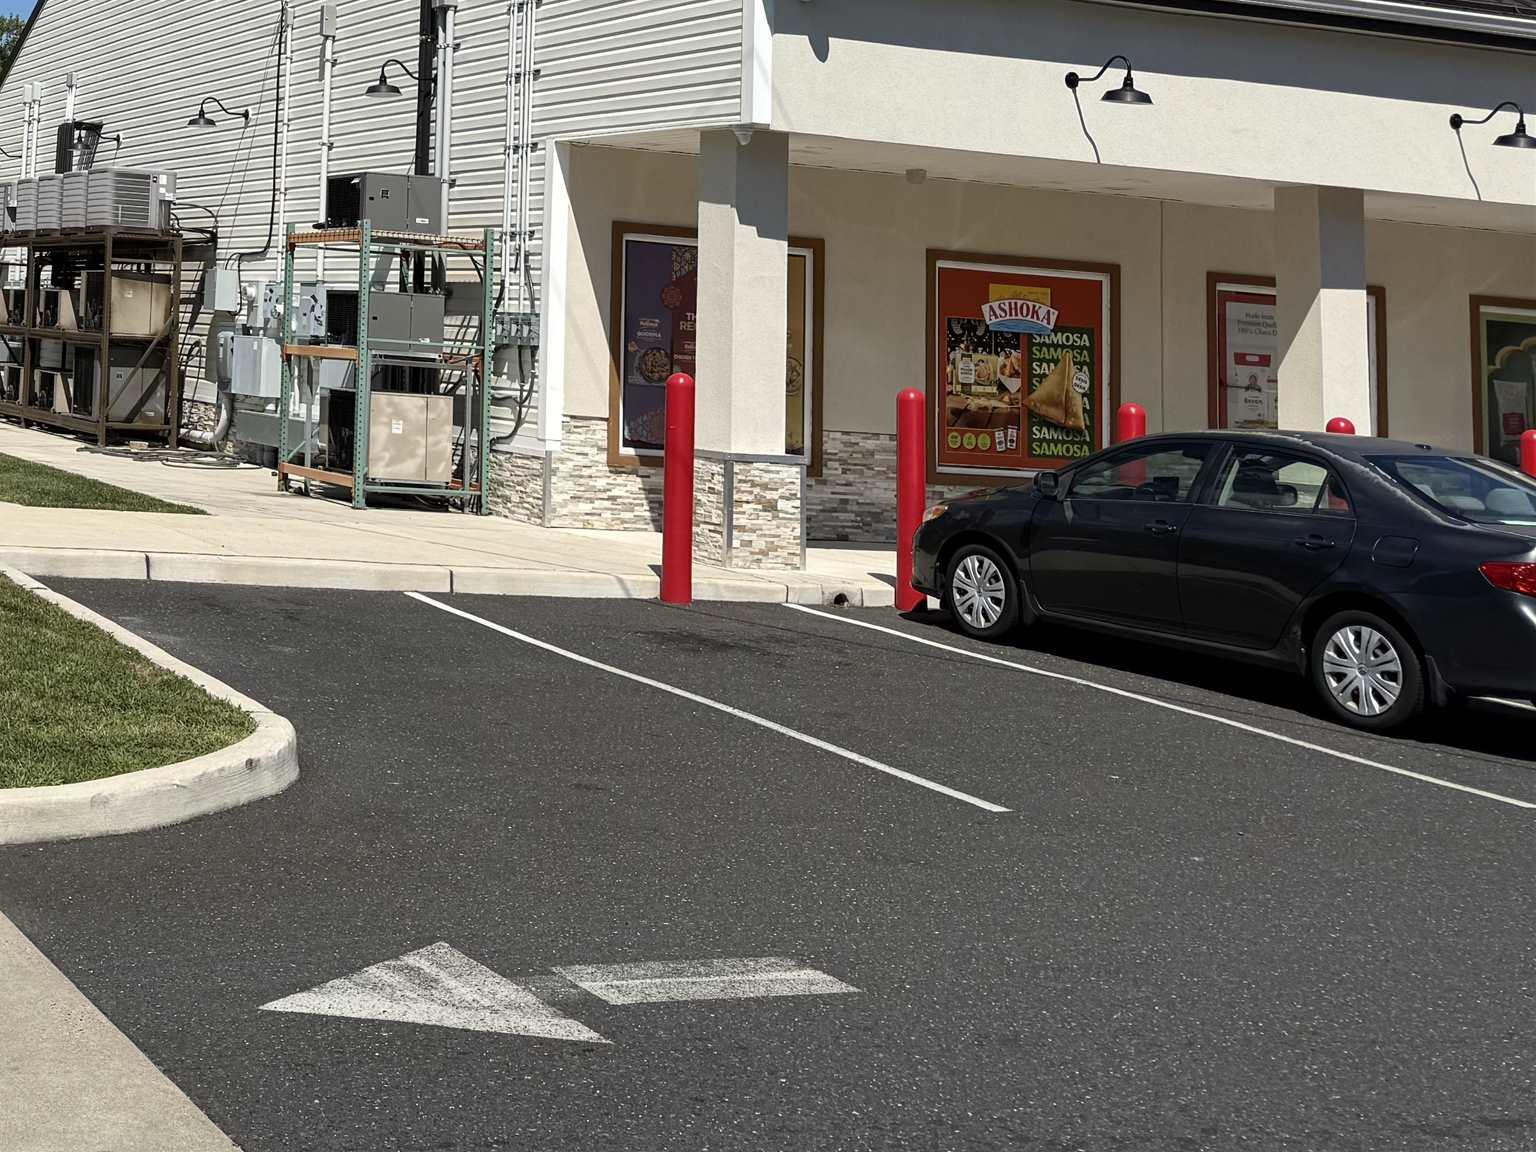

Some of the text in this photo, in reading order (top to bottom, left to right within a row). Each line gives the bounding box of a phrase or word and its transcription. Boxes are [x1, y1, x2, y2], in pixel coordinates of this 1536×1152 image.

[988, 301, 1051, 326] ASHOKA
[679, 321, 696, 331] RE
[1032, 332, 1090, 347] SAMOSA
[1032, 442, 1090, 457] SAMOSA
